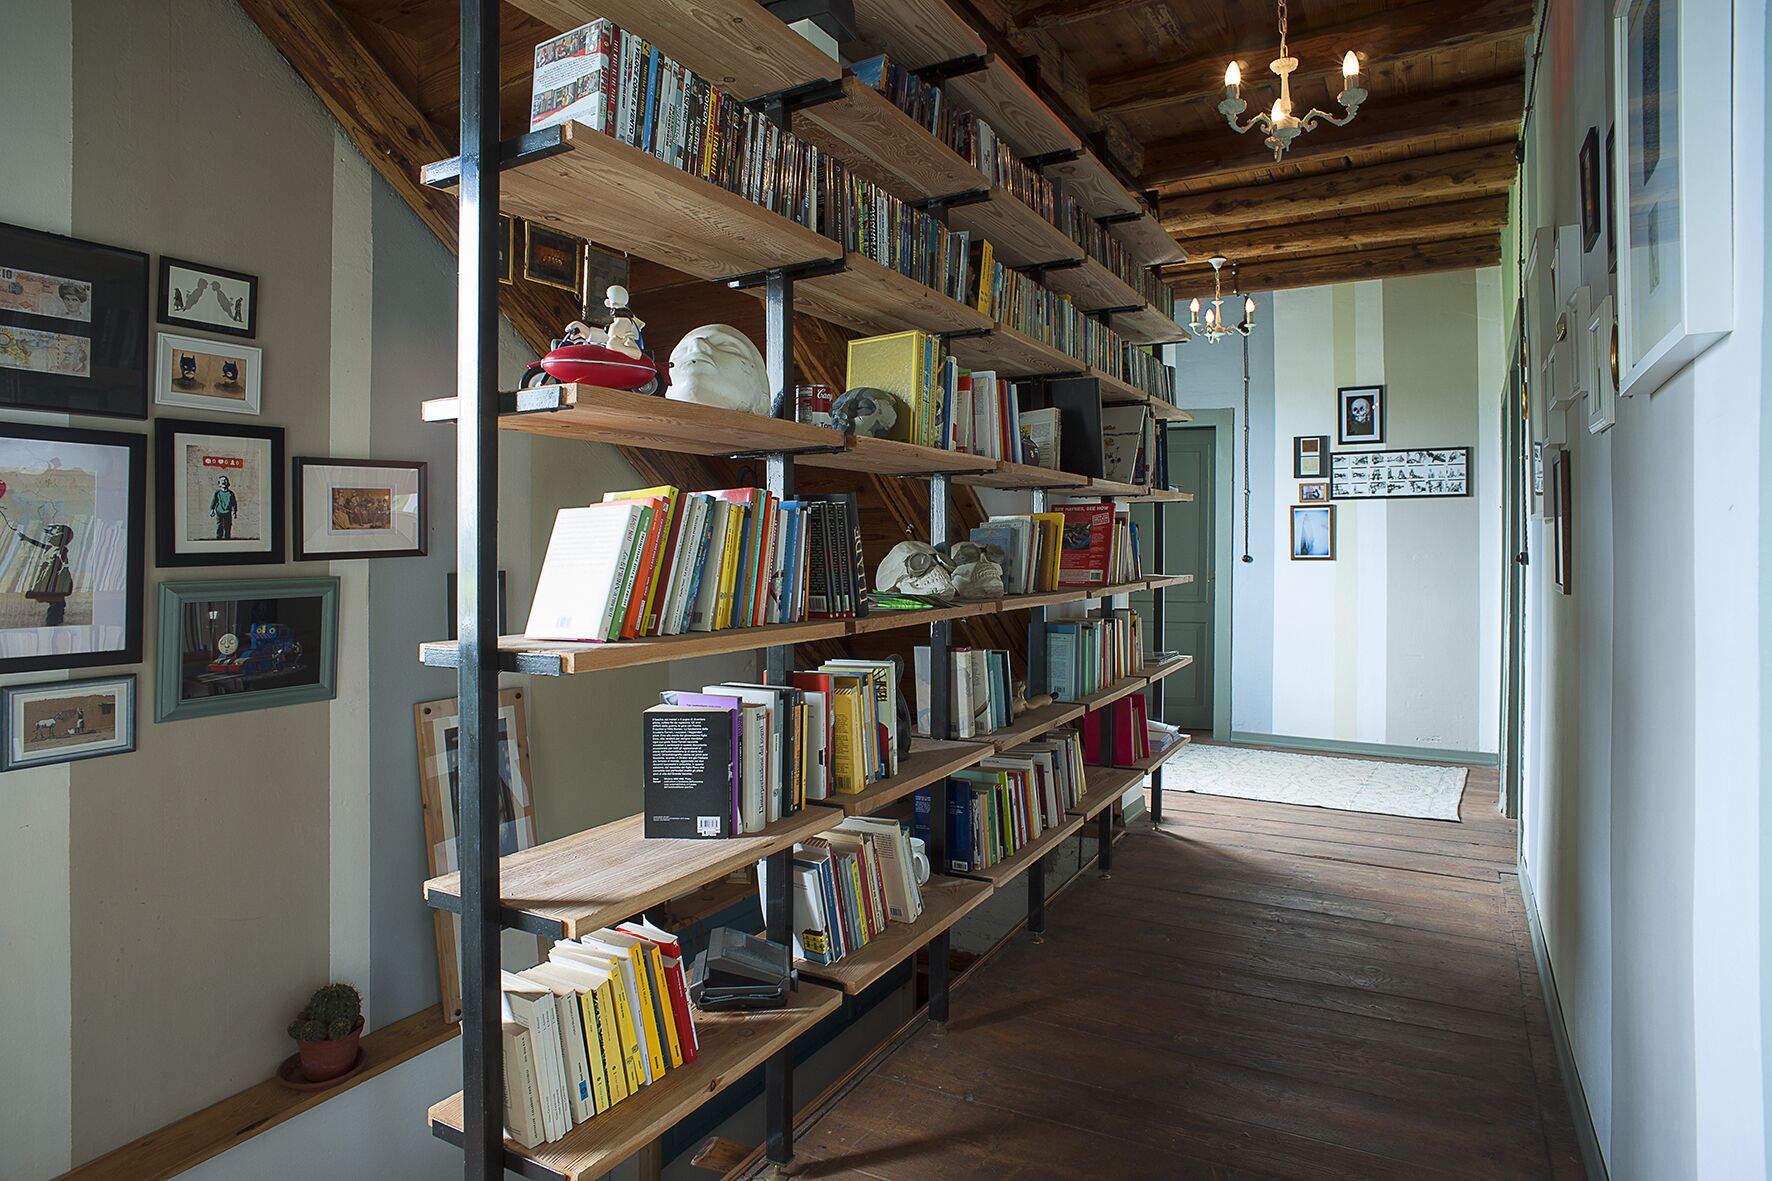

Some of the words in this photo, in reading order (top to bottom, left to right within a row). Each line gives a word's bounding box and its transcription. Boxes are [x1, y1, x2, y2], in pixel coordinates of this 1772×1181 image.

[633, 47, 641, 76] VELOCE
[631, 99, 636, 107] IL
[853, 527, 867, 605] ILIADE
